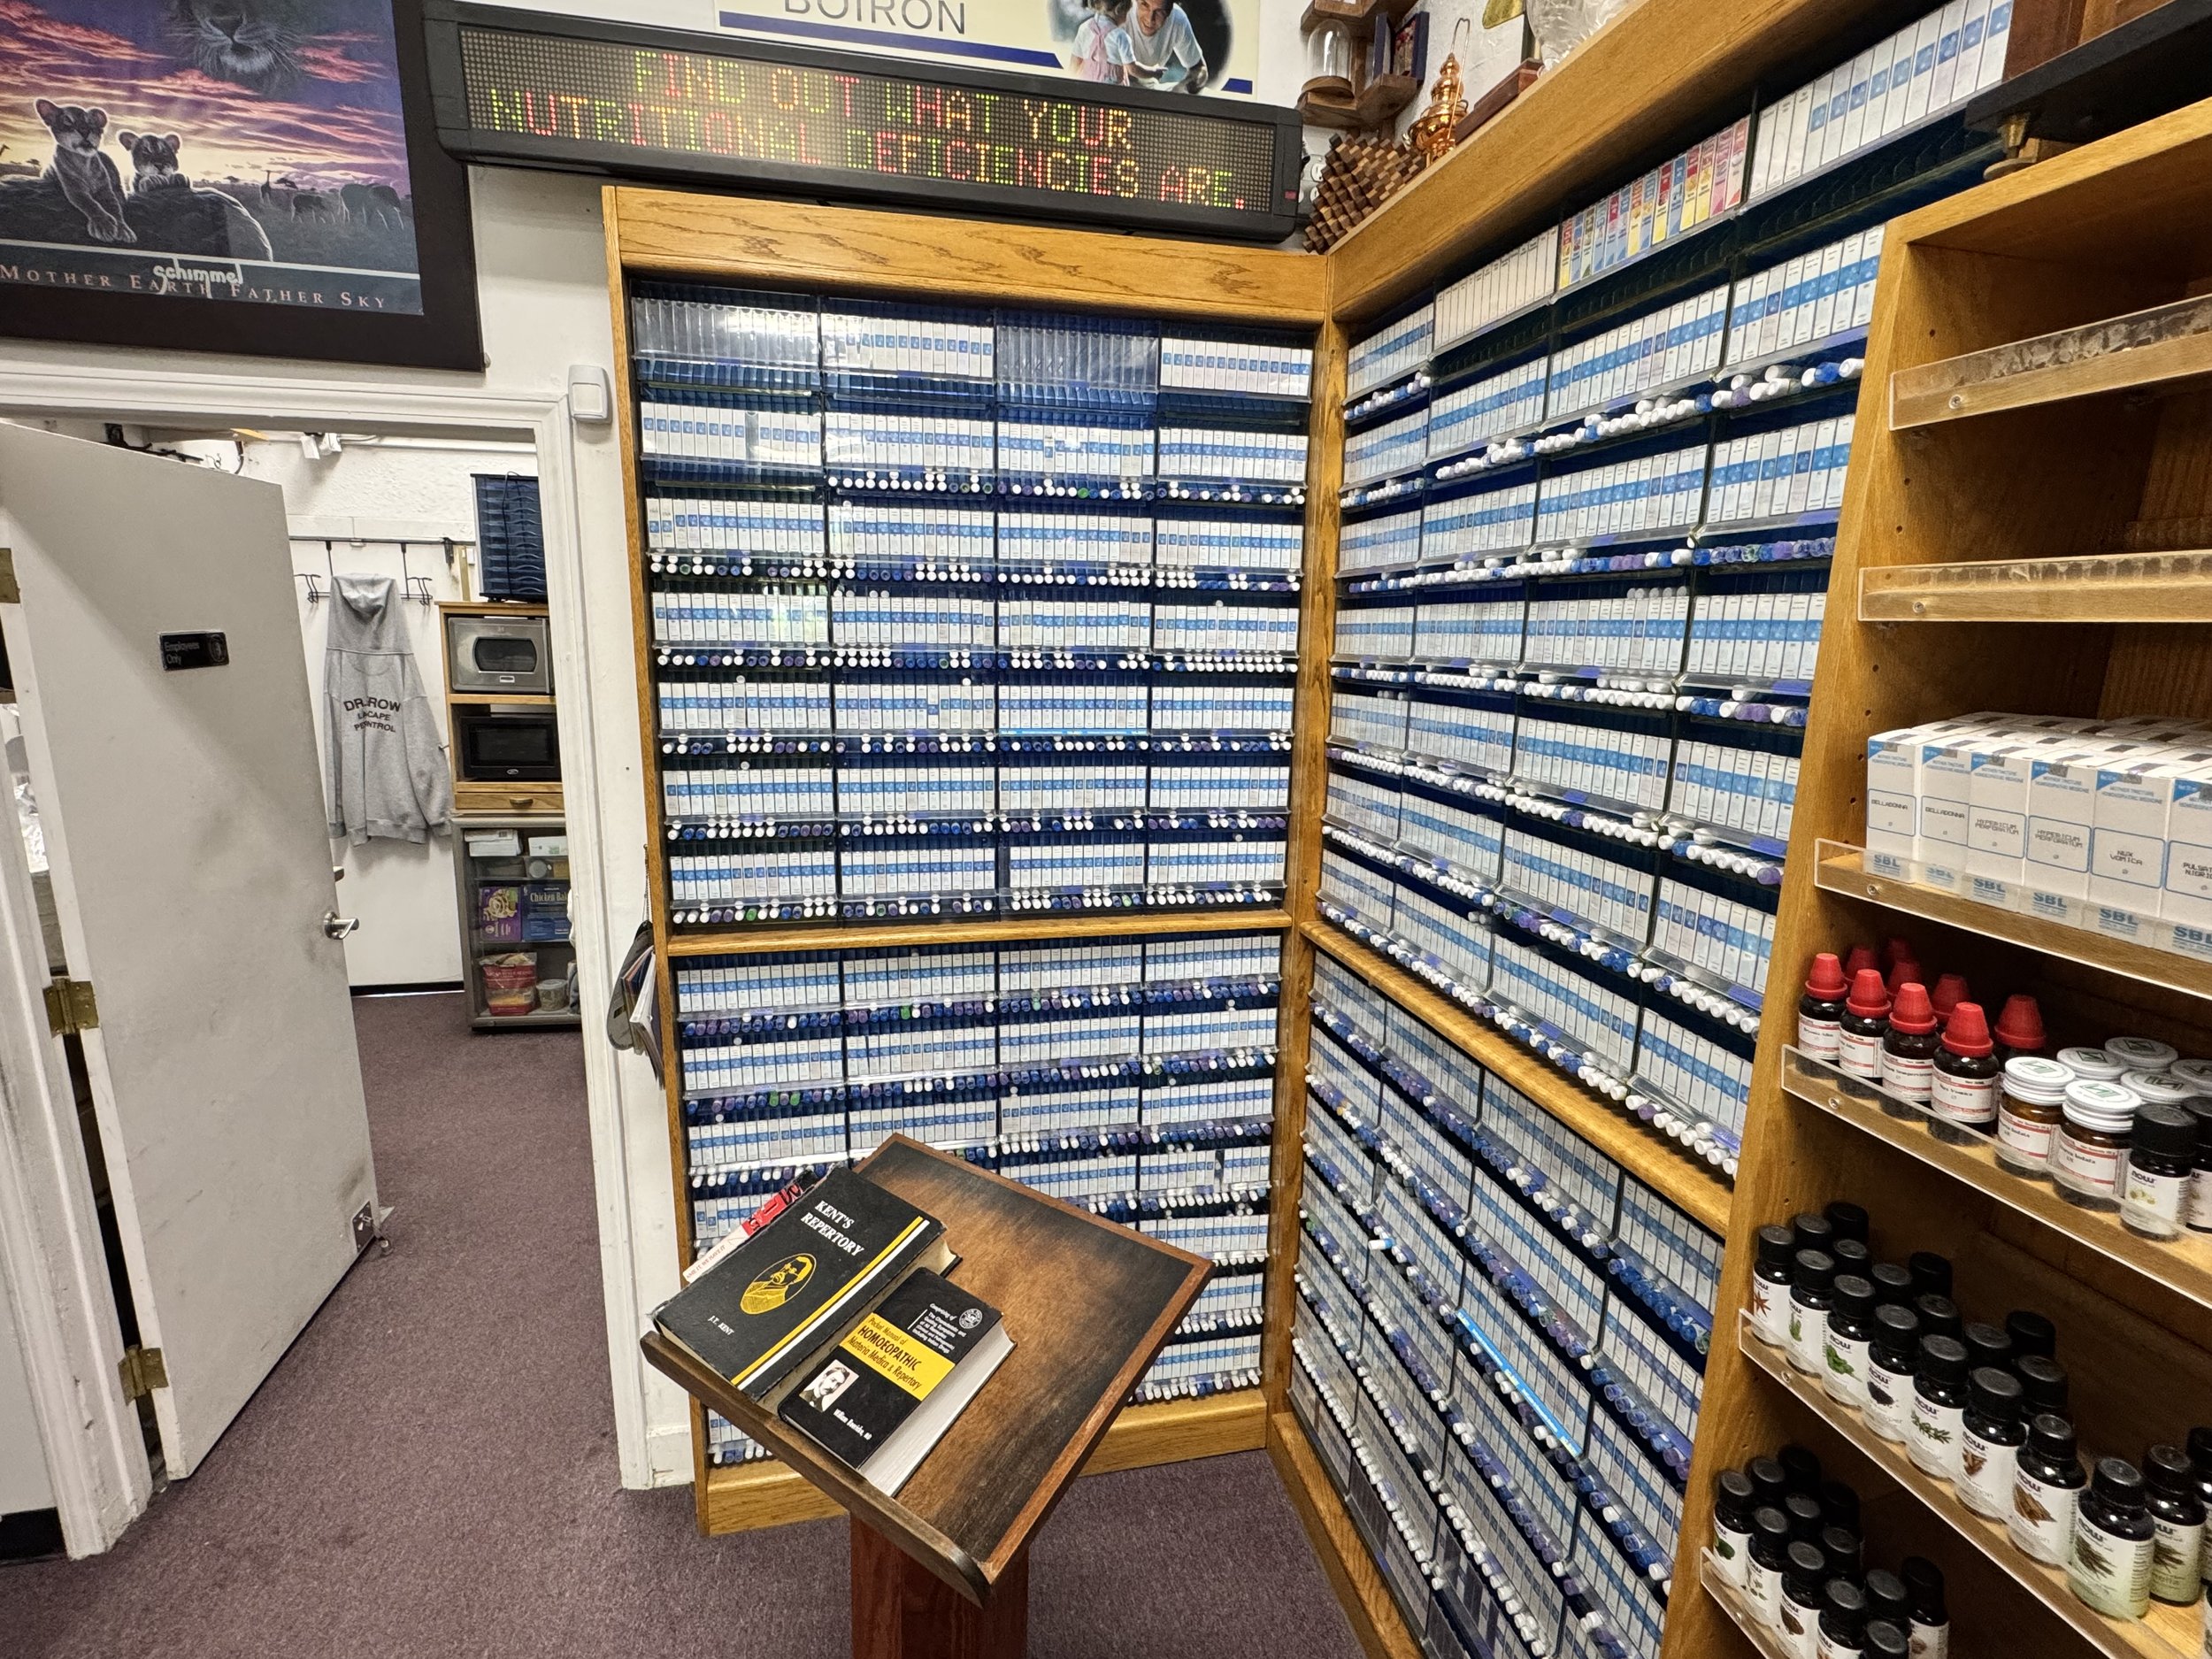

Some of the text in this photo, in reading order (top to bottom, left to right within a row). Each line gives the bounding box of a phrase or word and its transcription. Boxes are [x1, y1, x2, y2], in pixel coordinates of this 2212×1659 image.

[634, 50, 1133, 150] FIND OUT WHAT YOUR
[491, 88, 1246, 211] NUTRITIONAL DEFICIENCIES ARE.
[1871, 799, 1909, 810] BELLADONNA
[1924, 806, 1965, 819] BELLADONNA
[2038, 829, 2080, 842] HYPERICUM
[1874, 854, 1901, 868] SBL
[2109, 854, 2143, 866] VOMICA
[1973, 878, 2006, 893] SBL
[2033, 891, 2067, 909] SBL
[2099, 908, 2139, 926] SBL
[814, 1200, 856, 1230] KENT'S
[800, 1212, 865, 1257] REPERTORY
[883, 1327, 902, 1342] Manual
[856, 1325, 922, 1371] HOMOEOPATHIC
[849, 1335, 871, 1356] Materia
[868, 1349, 890, 1369] Medica
[892, 1365, 922, 1392] Repertory
